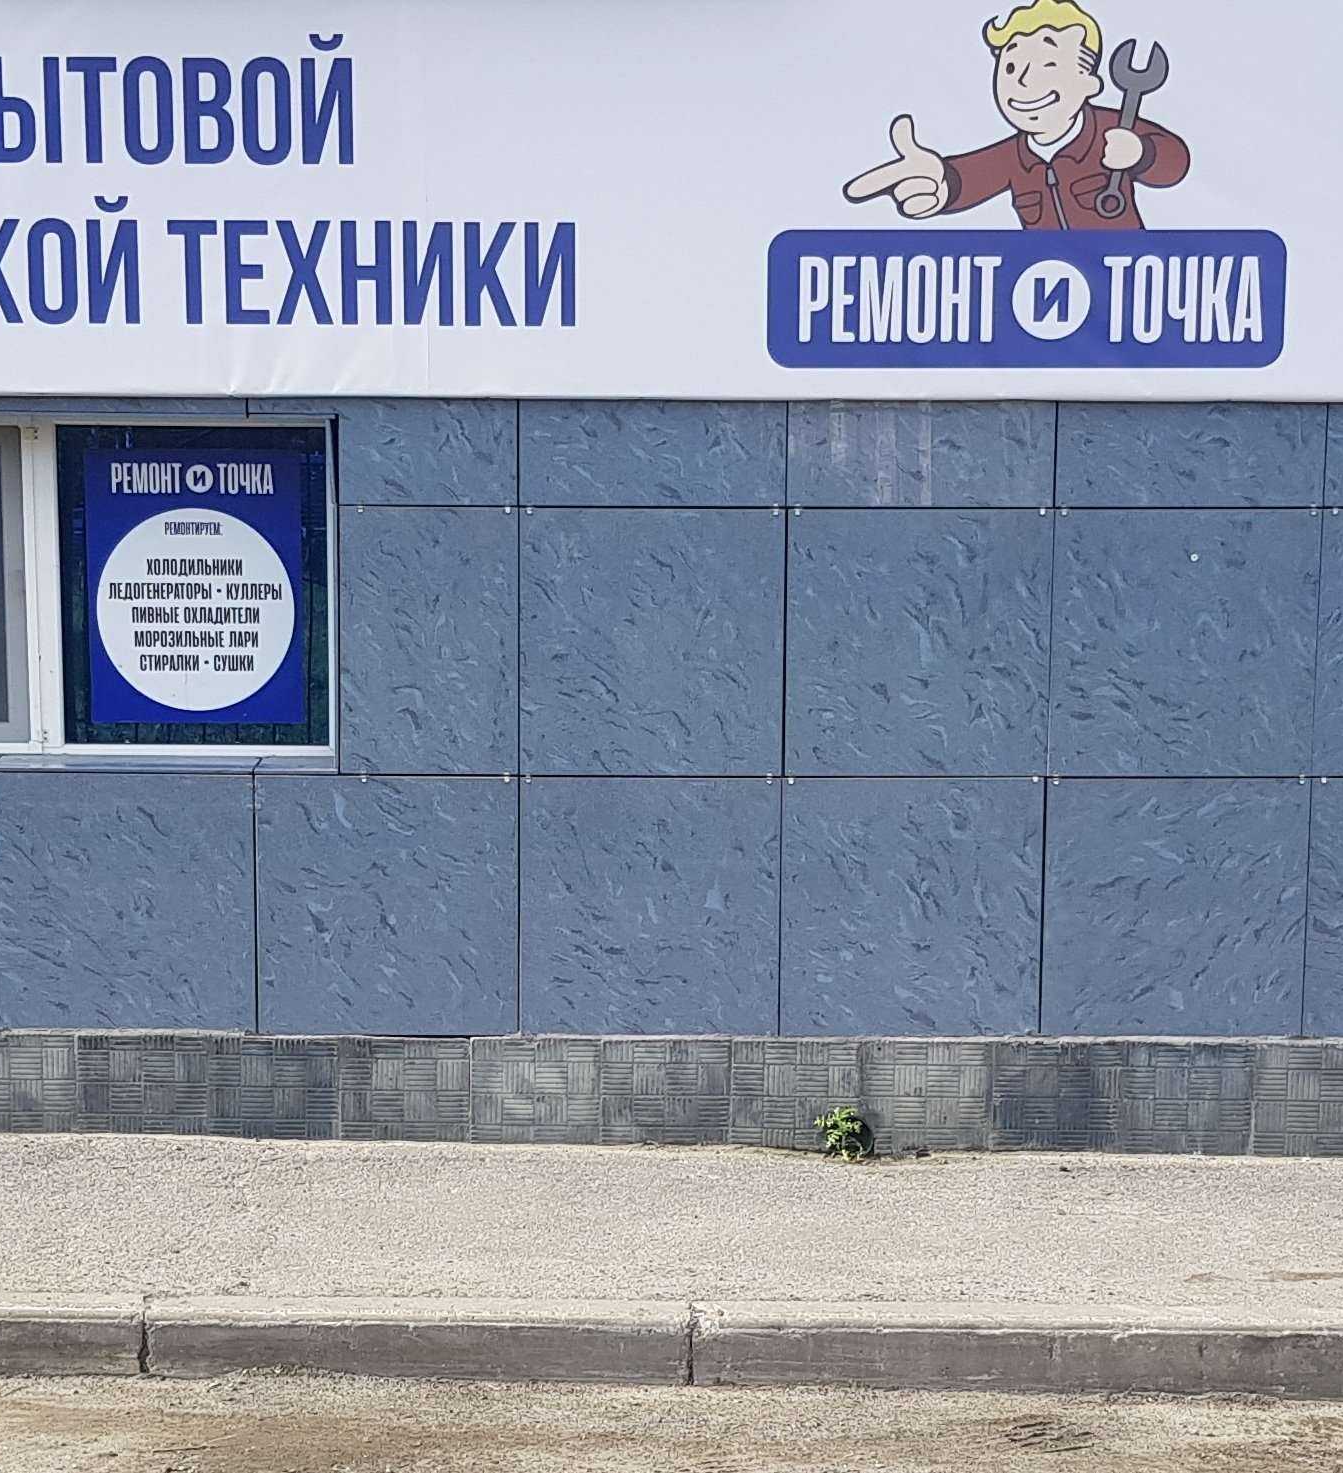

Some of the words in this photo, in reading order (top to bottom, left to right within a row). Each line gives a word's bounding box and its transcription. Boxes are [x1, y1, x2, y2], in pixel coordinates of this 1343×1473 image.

[166, 218, 577, 327] ТЕХНИКИ
[798, 255, 1002, 343] РЕМОНТ
[1103, 255, 1263, 343] ТОЧКА
[111, 463, 182, 494] РЕМОНТ
[217, 463, 274, 495] ТОЧКА
[146, 558, 243, 577] ХОЛОДИЛЬНИКИ
[108, 583, 212, 601] ЛЕДОГЕНЕРАТОРЫ
[226, 583, 282, 601] КУЛЛЕРЫ
[131, 607, 180, 624] ПИВНЫЕ
[184, 607, 260, 625] ОХЛАДИТЕЛИ
[134, 631, 224, 648] МОРОЗИЛЬНЫЕ
[229, 631, 259, 648] ЛАРИ
[139, 654, 200, 672] СТИРАЛКИ
[213, 654, 254, 672] СУШКИ
